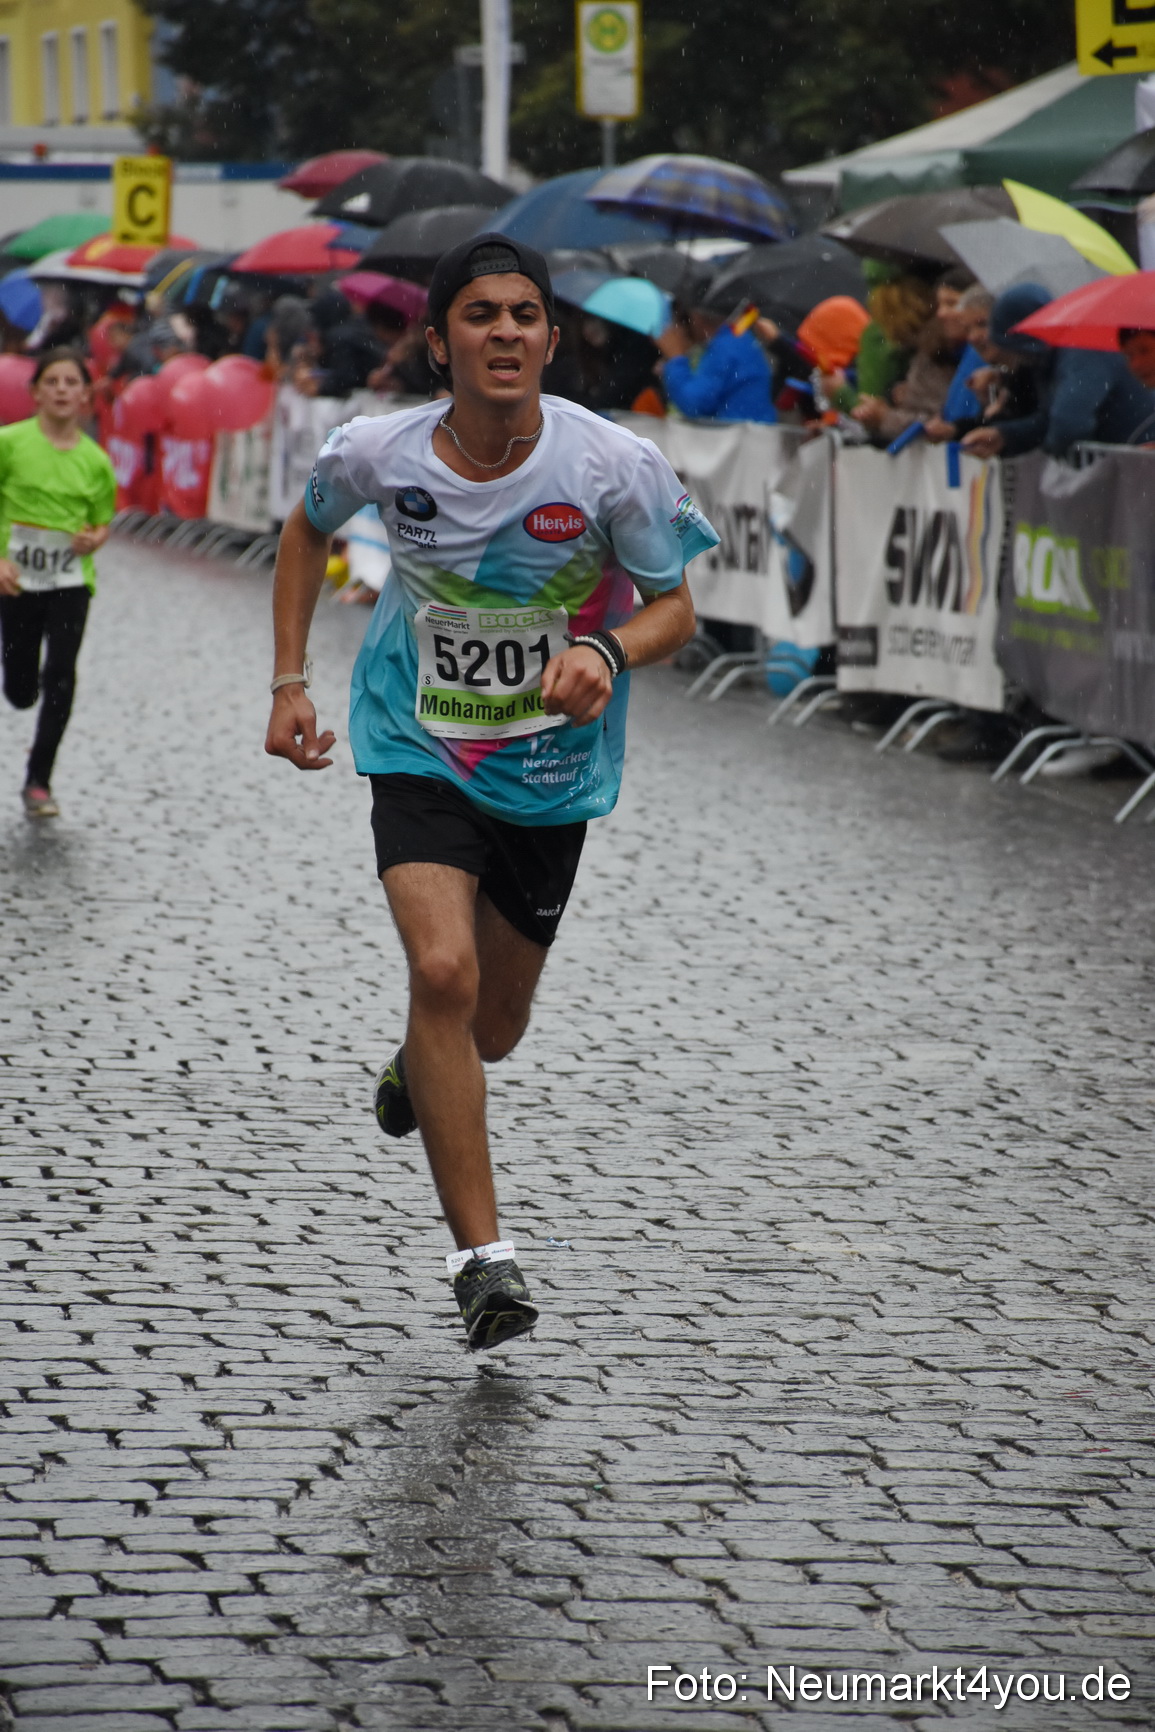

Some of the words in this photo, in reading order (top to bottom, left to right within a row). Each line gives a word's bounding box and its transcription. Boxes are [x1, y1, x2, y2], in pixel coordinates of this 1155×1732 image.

[127, 185, 155, 228] C
[533, 514, 582, 532] Hervis
[397, 523, 437, 543] PARTL
[15, 545, 75, 573] 4012
[425, 616, 470, 630] NeuerMarkt
[479, 610, 554, 628] BOCK
[433, 634, 550, 687] 5201
[424, 675, 431, 685] S
[420, 694, 516, 721] Mohamad
[526, 734, 560, 755] 17.
[522, 751, 591, 768] Neumarkter
[521, 767, 579, 784] Stadtlauf
